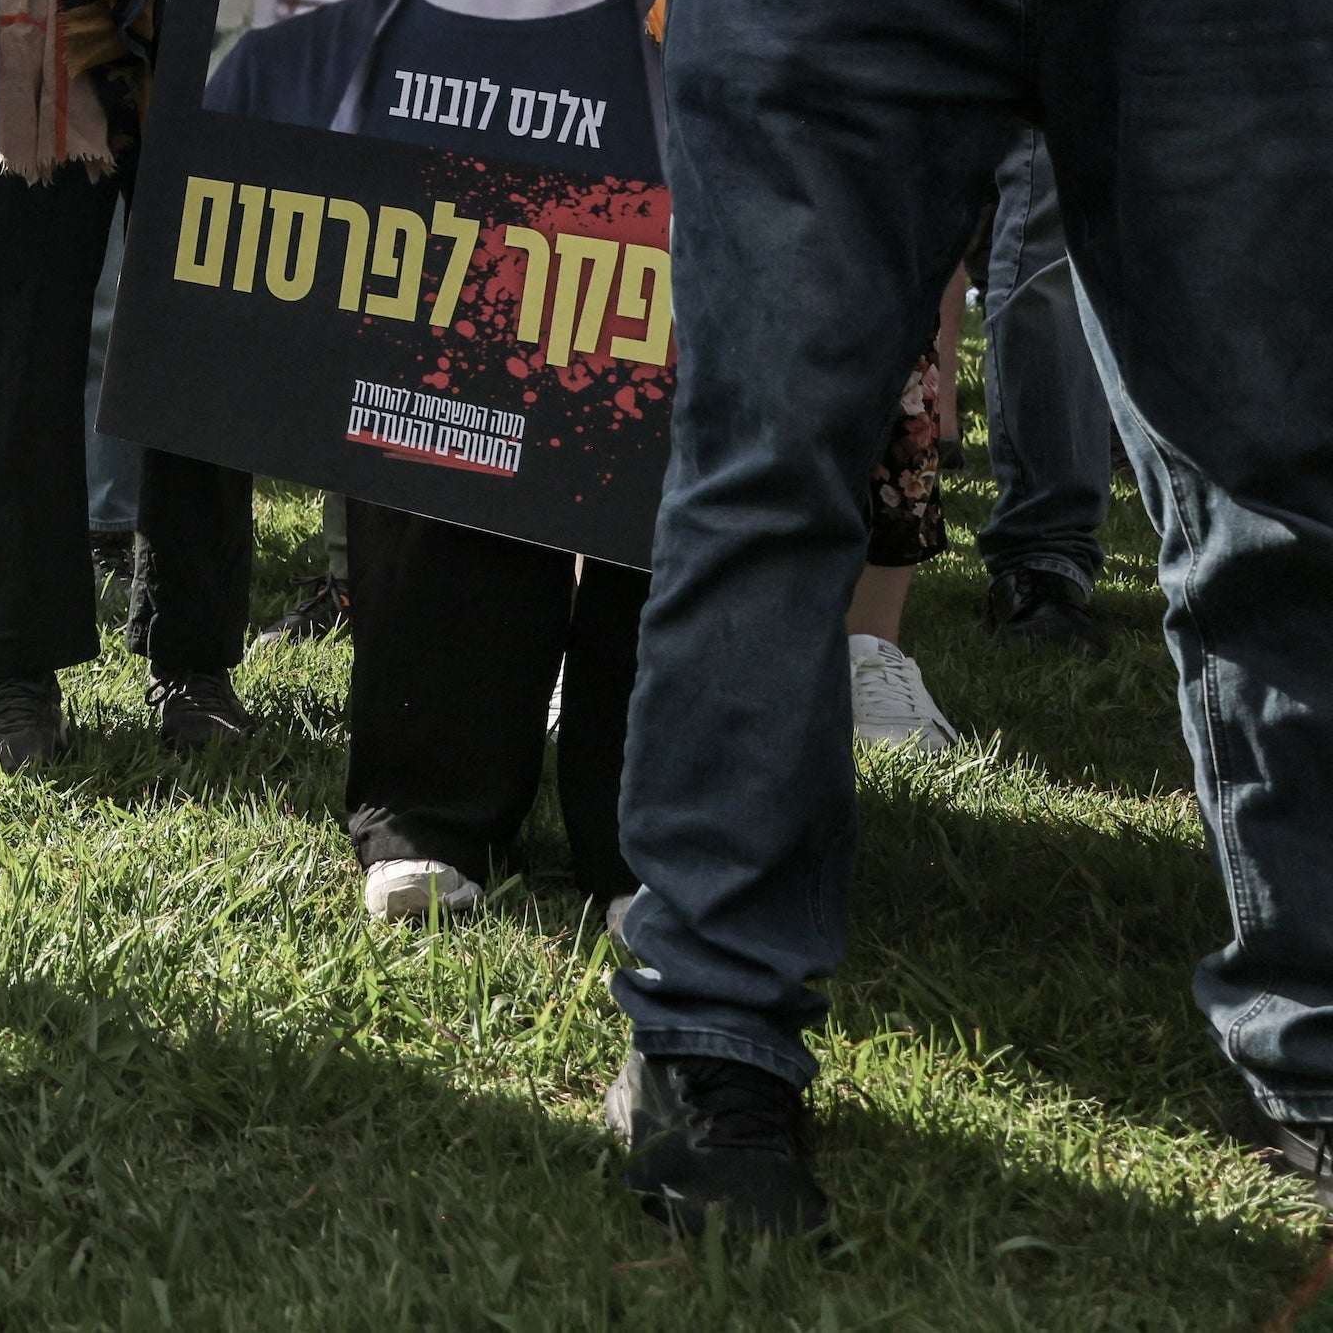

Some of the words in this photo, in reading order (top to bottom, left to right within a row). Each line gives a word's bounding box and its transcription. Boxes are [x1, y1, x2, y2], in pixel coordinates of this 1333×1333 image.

[388, 69, 501, 131] לובנוב
[507, 87, 607, 150] אלכס
[173, 175, 481, 329] לפרסום
[351, 379, 411, 413] להחזרת
[410, 391, 490, 431] המשפחות
[347, 405, 434, 453] והנעדרים
[434, 424, 523, 473] החטופים
[489, 409, 526, 440] מטה
